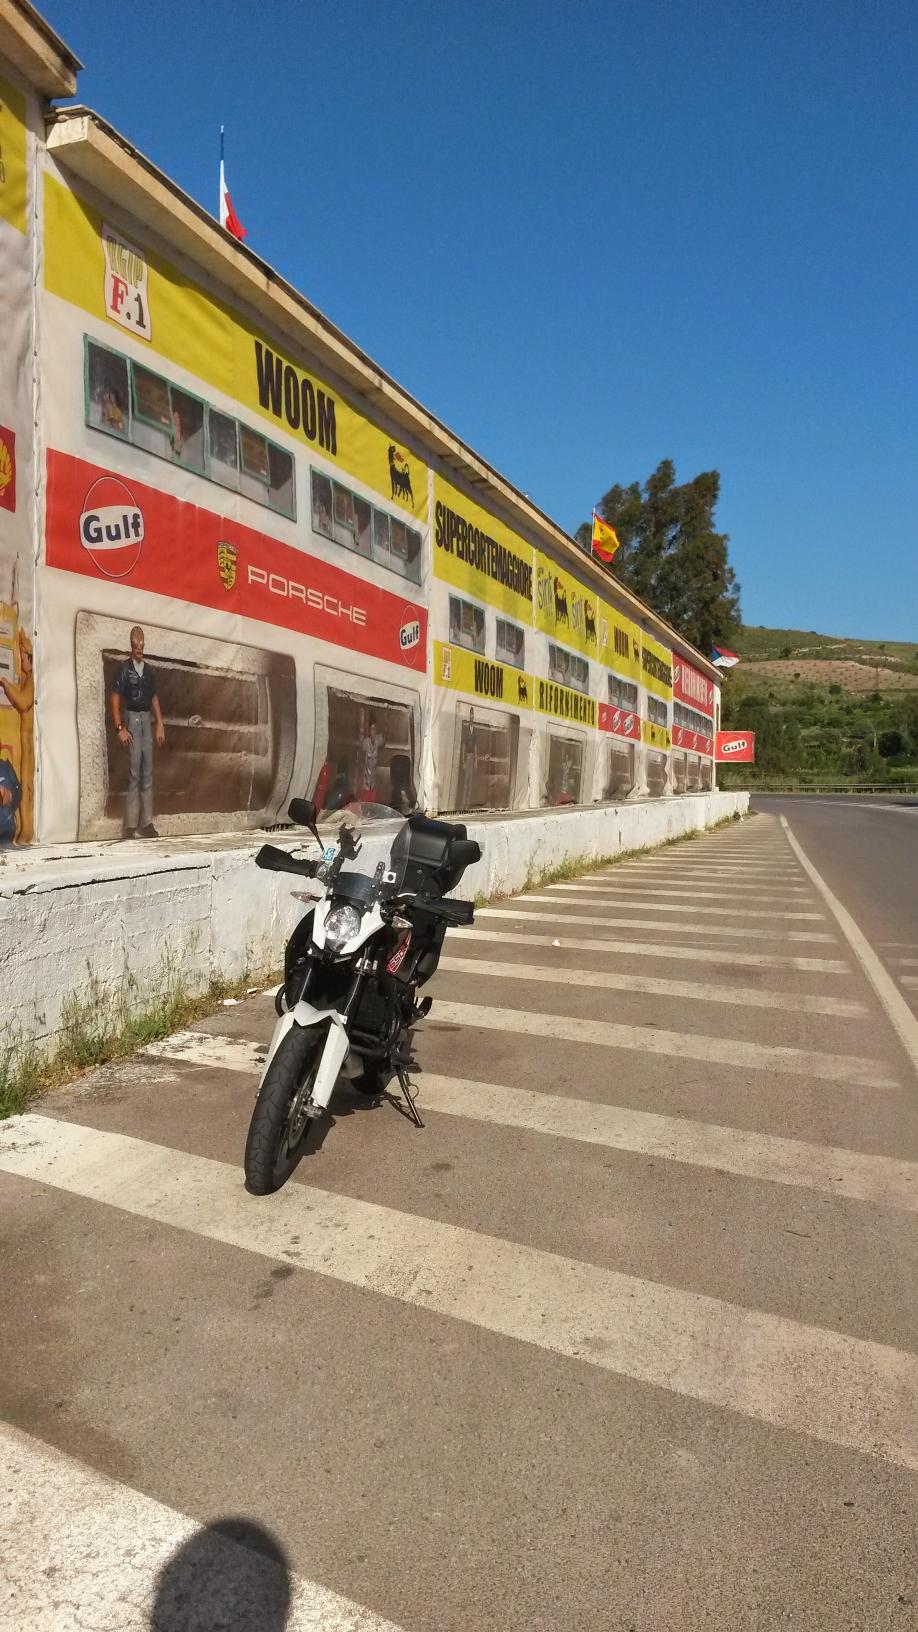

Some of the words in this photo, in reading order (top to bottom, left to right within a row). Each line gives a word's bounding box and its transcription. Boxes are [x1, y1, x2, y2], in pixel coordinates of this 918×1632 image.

[255, 339, 338, 456] WOOM
[83, 513, 143, 544] Gulf
[435, 499, 533, 602] SUPERCORTEMAGGIORE
[247, 565, 367, 627] PORSCHE
[400, 626, 420, 647] Gulf
[474, 659, 504, 699] WOOM
[539, 680, 595, 726] RIFORNIMENTO
[722, 741, 747, 753] Gulf
